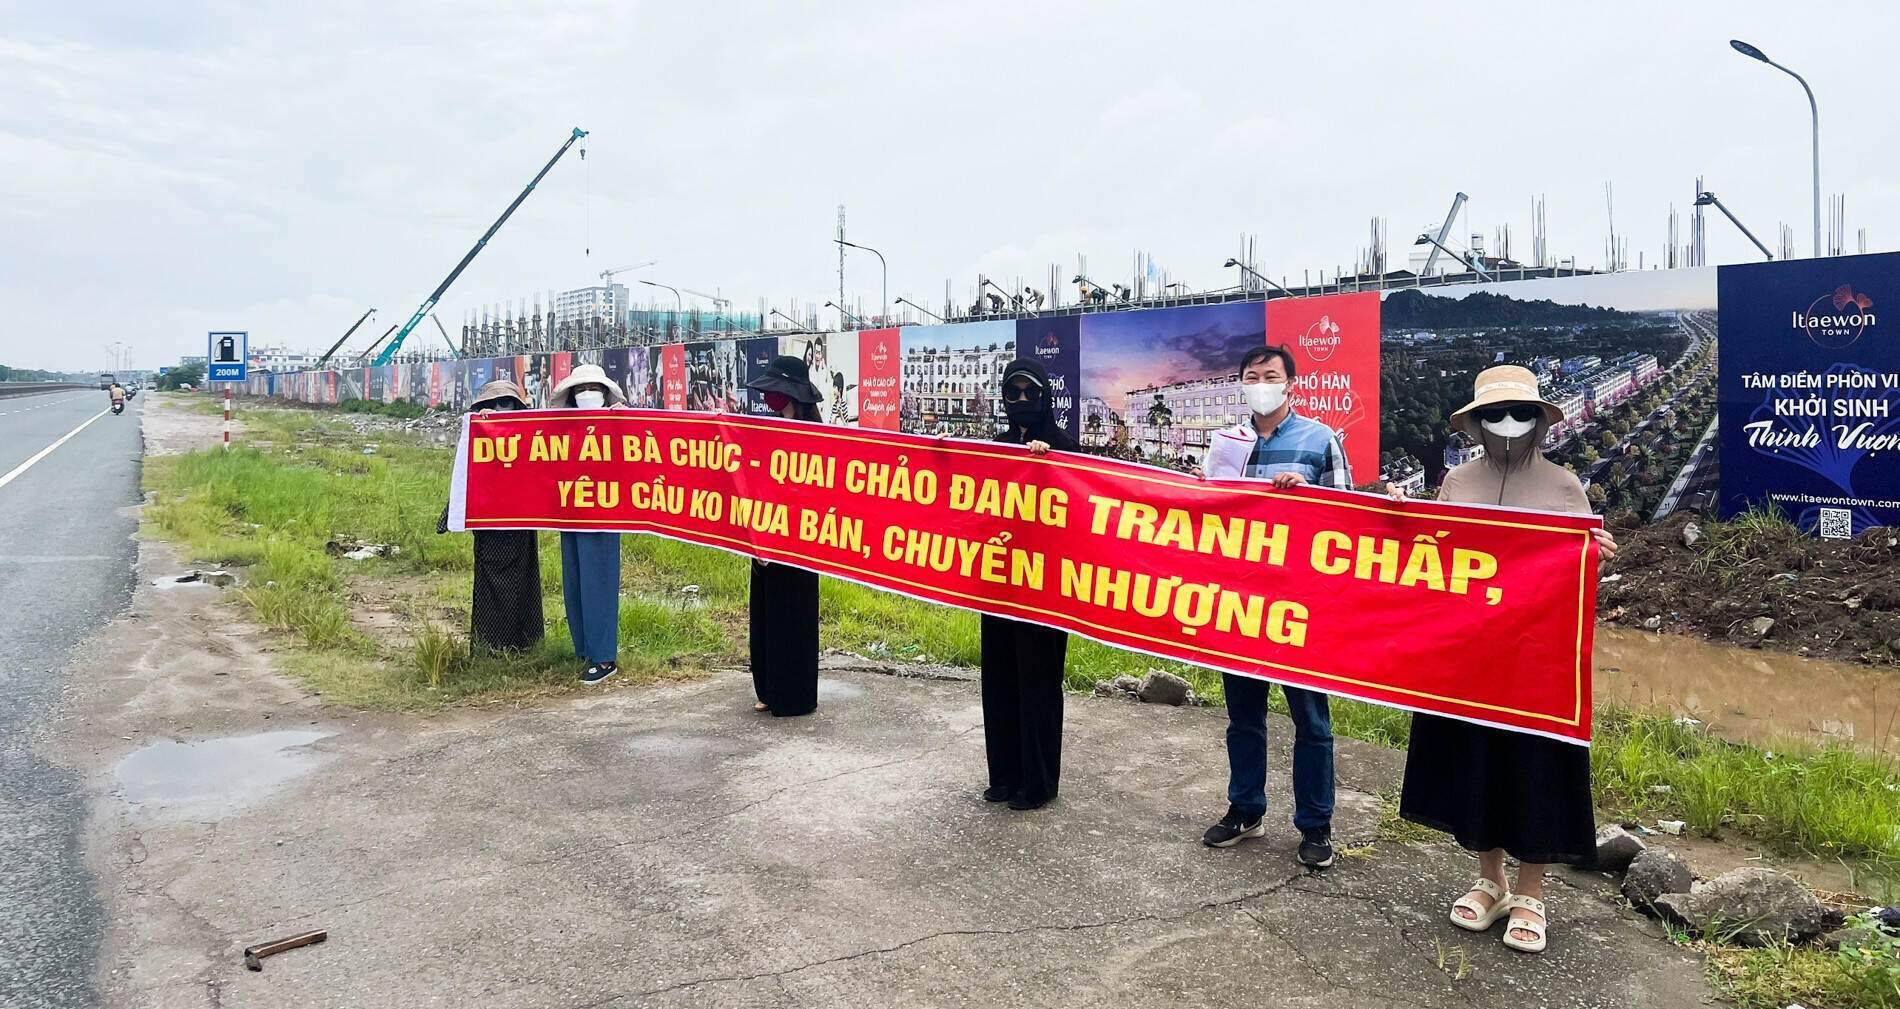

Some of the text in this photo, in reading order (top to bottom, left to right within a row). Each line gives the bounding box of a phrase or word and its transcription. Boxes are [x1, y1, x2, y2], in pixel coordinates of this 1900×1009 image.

[1792, 311, 1876, 329] Itaewon
[1299, 335, 1341, 347] Itaewon
[215, 368, 239, 377] 200M
[1321, 371, 1351, 390] HÀN
[1741, 371, 1776, 389] TÂM
[1780, 369, 1822, 389] ĐIỂM
[1827, 369, 1877, 389] PHỒN
[1289, 392, 1353, 415] bên ĐẠI LỘ
[1775, 393, 1889, 418] KHỞI SINH
[1743, 420, 1822, 453] Thịnh
[1771, 493, 1900, 509] www.itaewontown.com
[473, 433, 521, 468] DỰ
[529, 431, 570, 462] ÁN
[578, 425, 612, 462] ẢI
[623, 431, 662, 464] BÀ
[670, 434, 742, 472] CHÚC
[769, 449, 836, 488] QUAI
[845, 455, 938, 505] CHẢO
[949, 474, 1068, 528] ĐANG
[1088, 495, 1290, 568] TRANH
[1310, 530, 1503, 605] CHẤP,
[558, 474, 1310, 648] YÊU CẦU KO MUA BÁN, CHUYỂN NHƯỢNG
